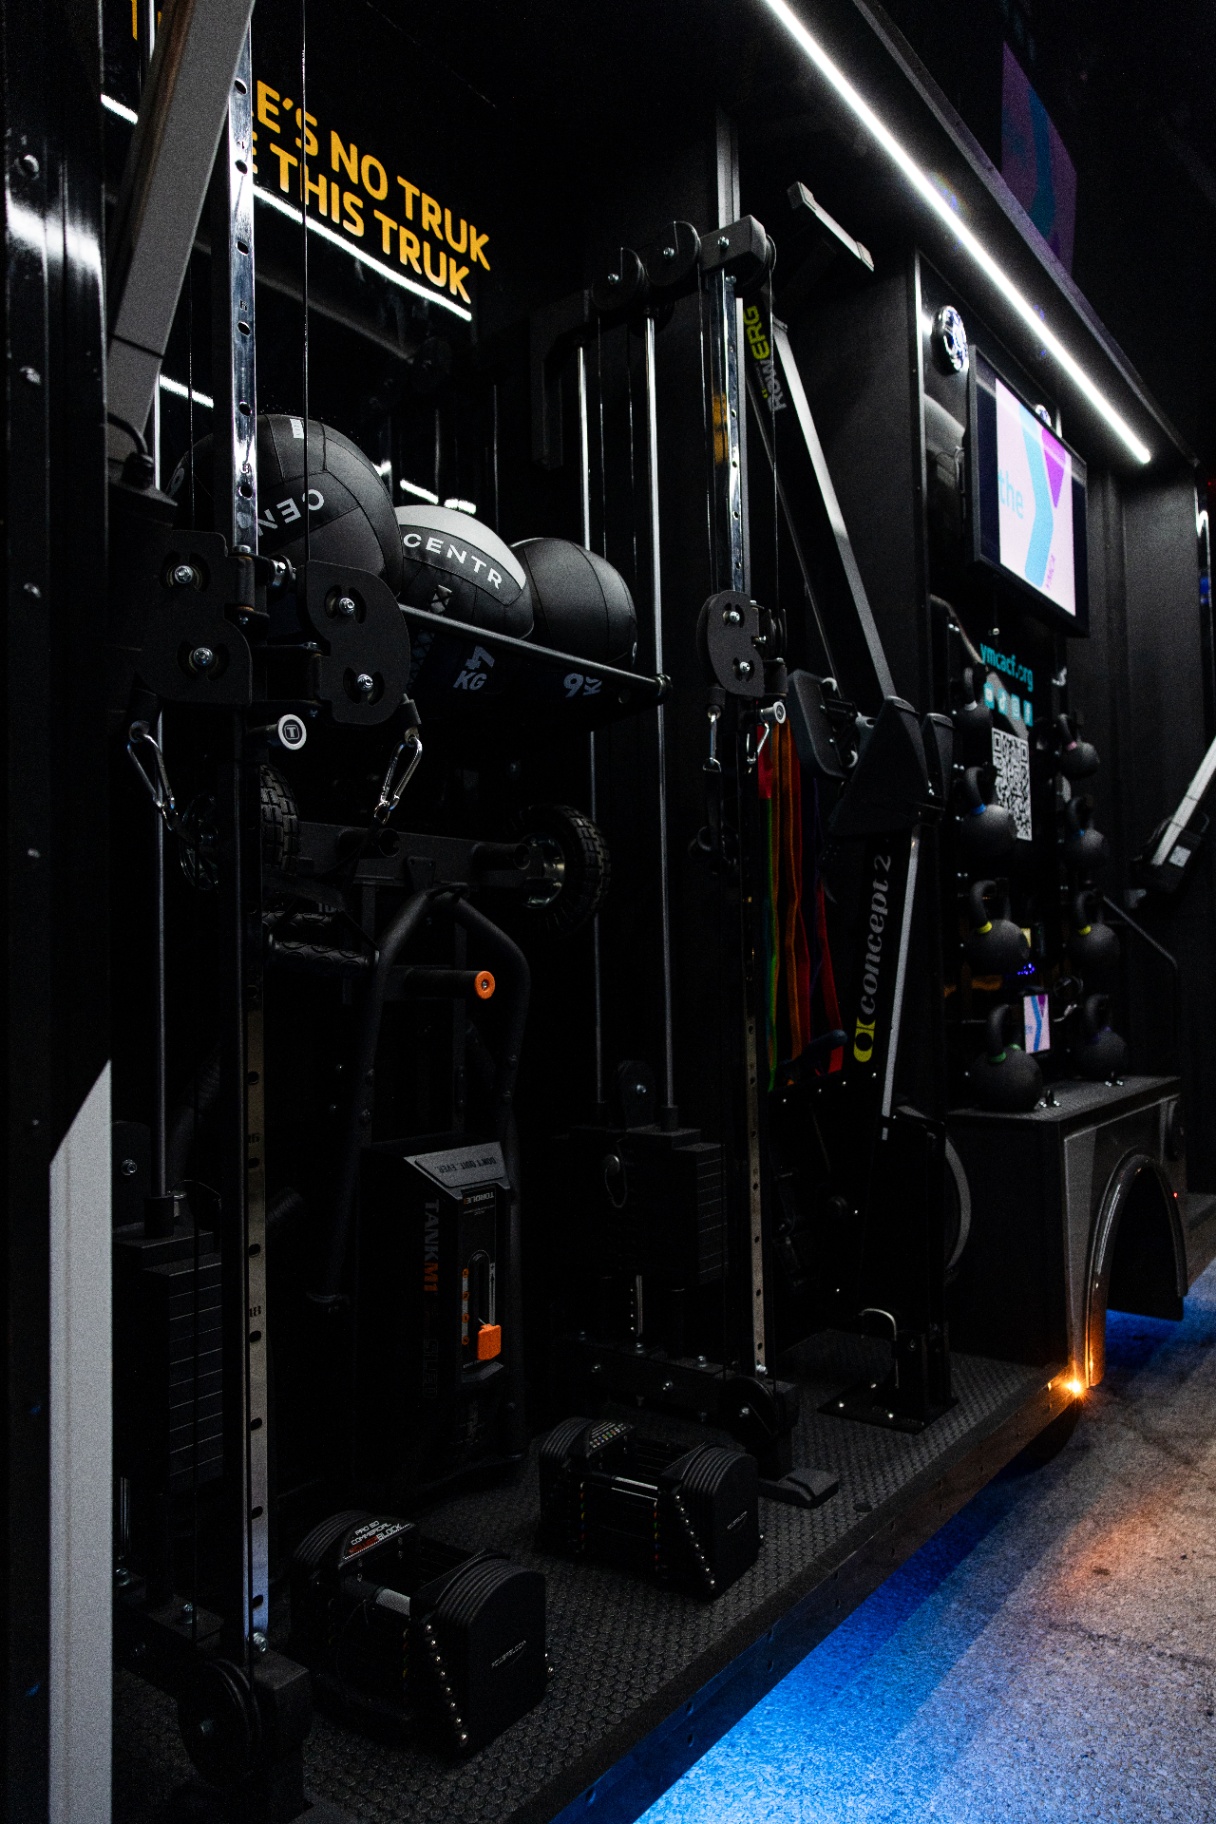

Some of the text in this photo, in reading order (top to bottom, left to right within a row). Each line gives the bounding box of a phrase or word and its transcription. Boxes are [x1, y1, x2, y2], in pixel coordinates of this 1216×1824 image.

[252, 79, 319, 157] E'S
[330, 129, 389, 202] NO
[396, 175, 492, 272] TRUK
[269, 143, 365, 238] THIS
[374, 209, 472, 305] TRUK
[998, 468, 1024, 520] the
[403, 533, 502, 590] CENTR
[452, 669, 488, 691] KG
[563, 672, 584, 698] 9
[859, 854, 891, 1015] concept 2
